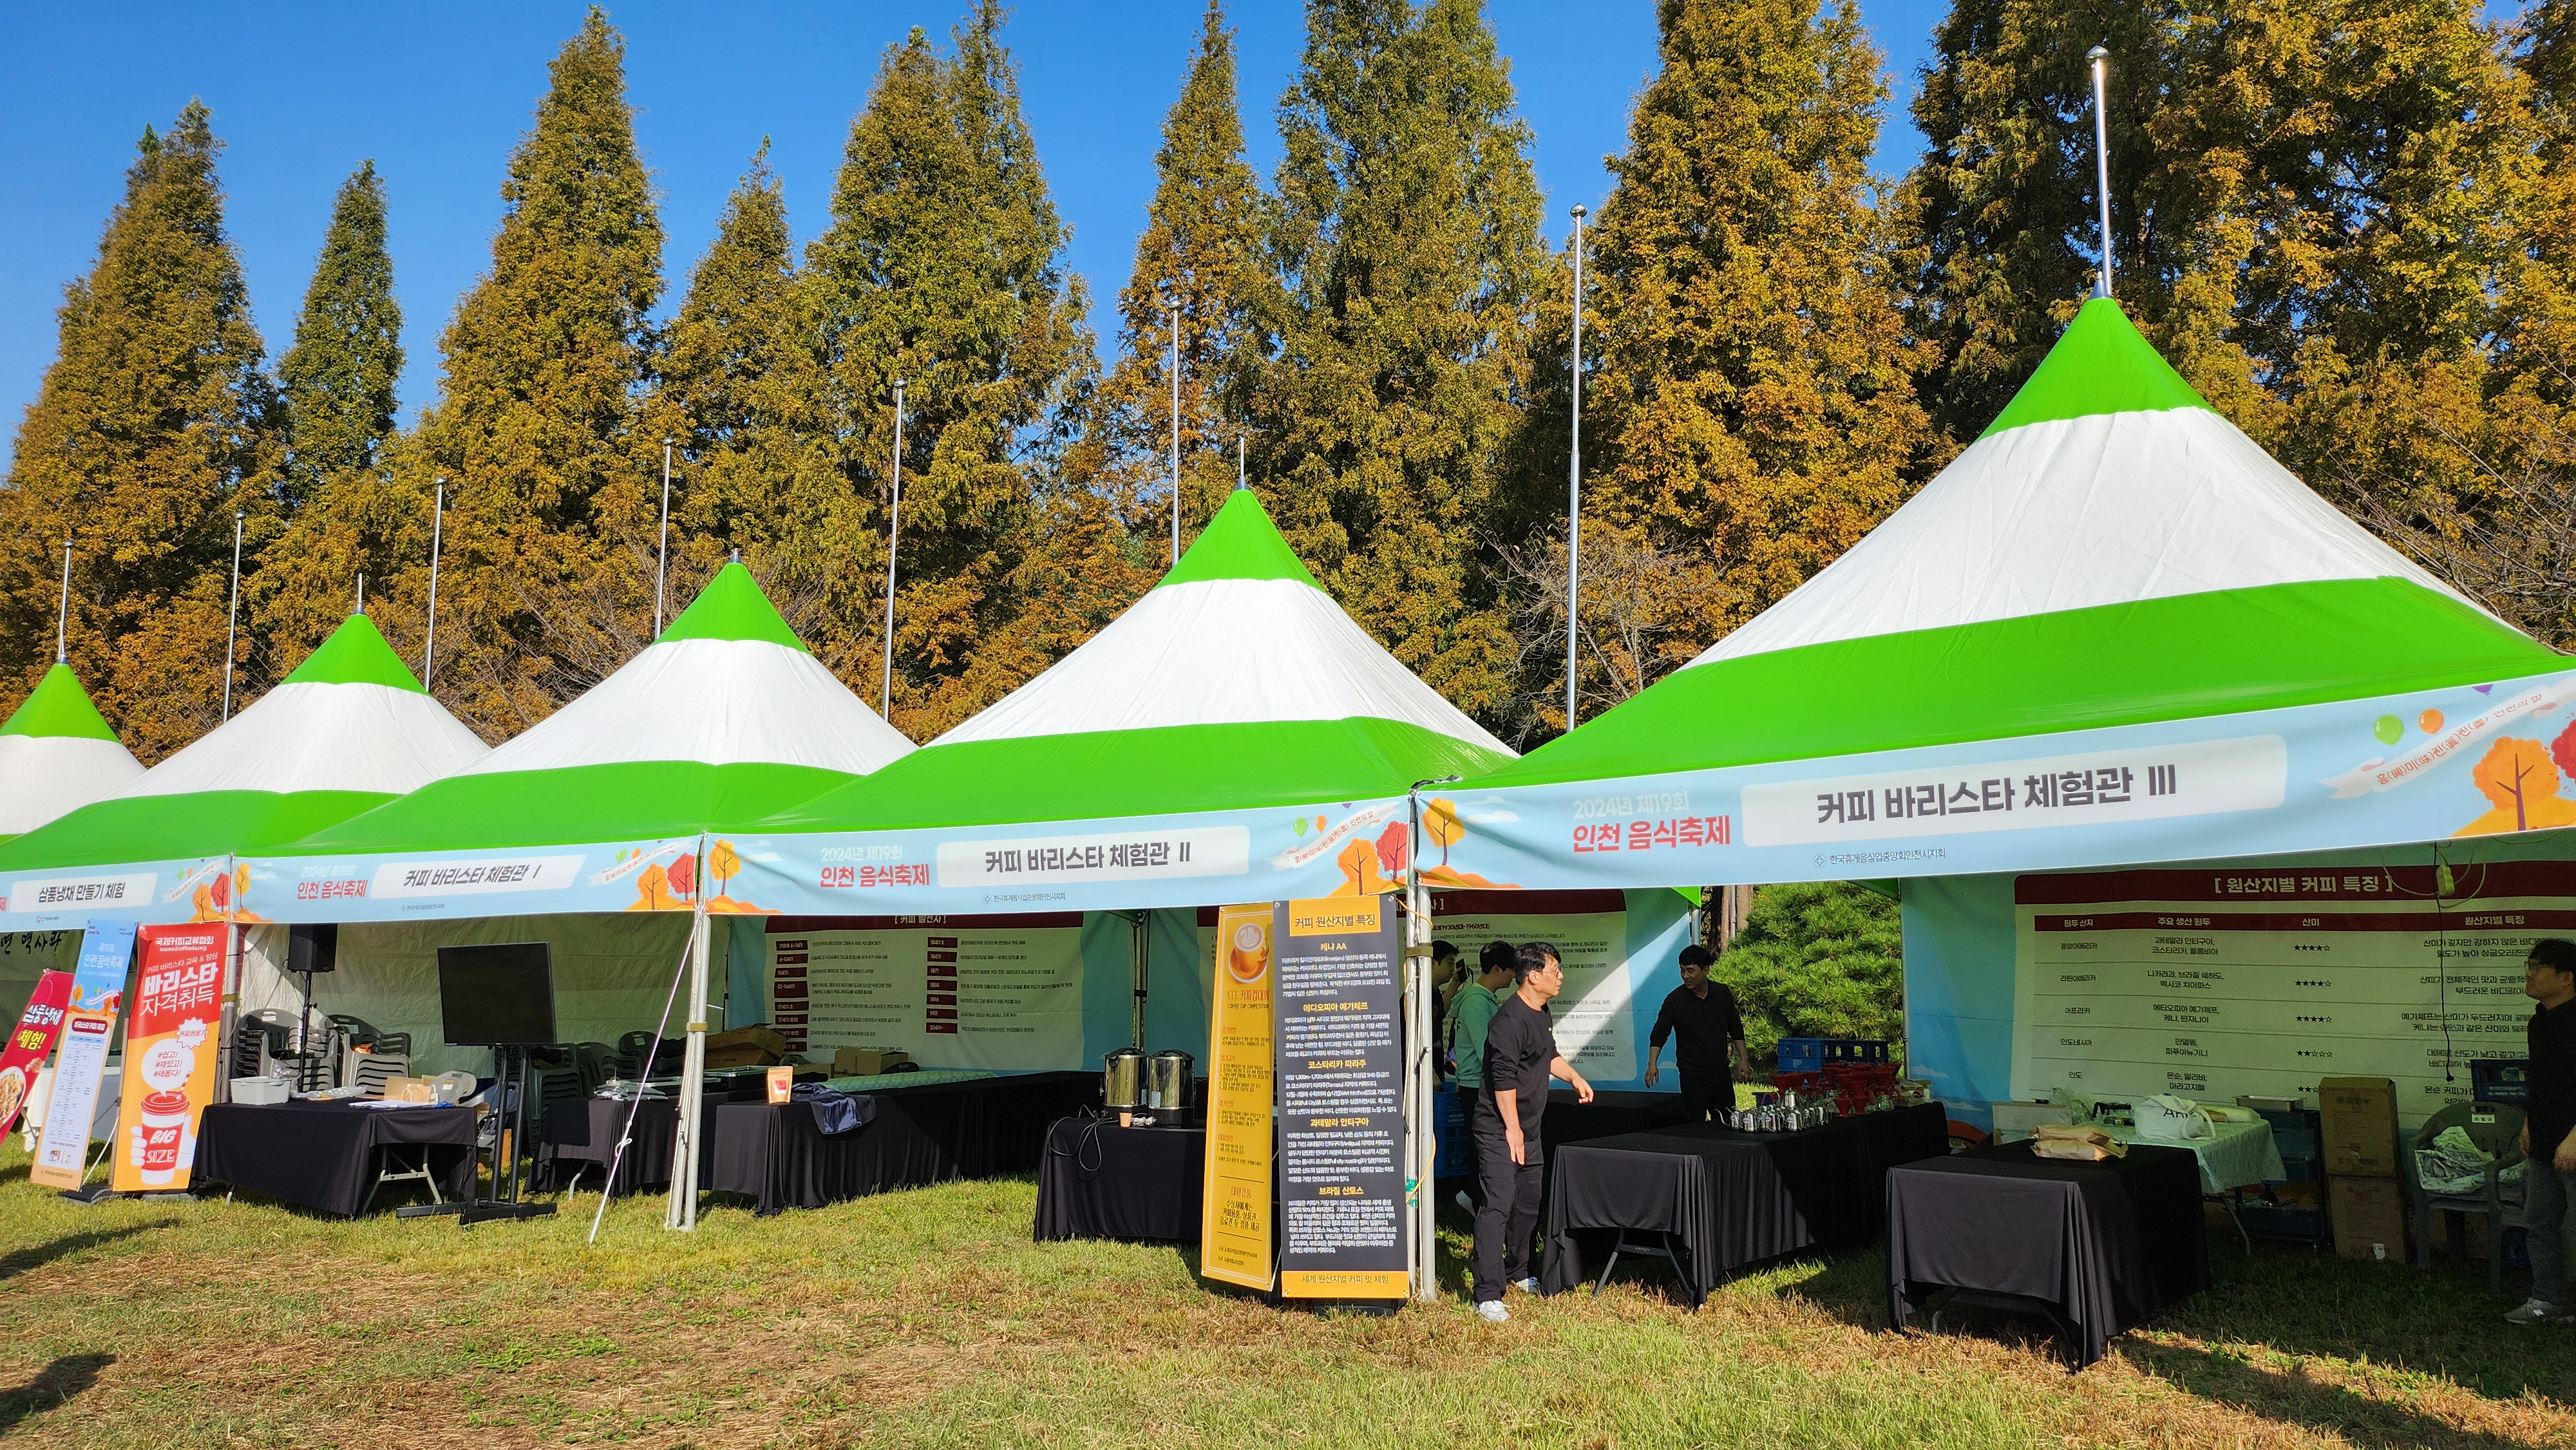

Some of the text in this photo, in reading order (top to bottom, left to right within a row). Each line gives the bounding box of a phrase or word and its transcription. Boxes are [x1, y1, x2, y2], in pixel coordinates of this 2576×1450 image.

[2494, 699, 2528, 718] 인천의
[1817, 789, 1875, 824] 커피
[1885, 777, 2015, 819] 바리스타
[2023, 764, 2134, 808] 체험관
[1573, 791, 1689, 819] 2024년 제19회
[1573, 815, 1731, 853] 인천 음식축제
[821, 844, 902, 862] 2024년 제19회
[985, 851, 1022, 873] 커피
[1027, 846, 1104, 871] 바리스타
[1109, 843, 1170, 868] 체험관
[1830, 848, 1946, 865] 한국휴게음식업중앙회인천시지회
[301, 864, 357, 878] 2024년 제19회
[403, 869, 433, 887] 커피
[431, 867, 484, 885] 바리스타
[484, 865, 529, 883] 체험관
[820, 863, 929, 888] 인천 음식축제
[76, 883, 105, 901] 만들기
[104, 882, 126, 899] 체험
[297, 880, 368, 899] 인천 음식축제
[2226, 876, 2378, 893] 원산지별 커피 특징
[900, 915, 915, 923] 커피
[1295, 914, 1376, 928] 커피 원산지별 특징
[2079, 919, 2093, 927] 산지
[2158, 918, 2174, 926] 주요
[2176, 918, 2192, 926] 생산
[2194, 918, 2210, 926] 원두
[2302, 918, 2320, 927] 산미
[2465, 916, 2503, 925] 원산지별
[2505, 915, 2524, 925] 특징
[156, 936, 214, 946] 국제커피교류협회
[1320, 943, 1335, 951] 케냐
[2155, 937, 2183, 945] 과테말라
[2474, 938, 2499, 946] 강하지
[84, 954, 125, 969] 인천 음식축제
[160, 959, 185, 970] 바리스타
[206, 952, 218, 961] 양성
[144, 962, 219, 996] 바리스타
[2060, 974, 2096, 983] 라틴아메리카
[2183, 981, 2211, 990] 치아파스
[140, 984, 215, 1016] 자격취득
[1227, 990, 1269, 1001] CCC 커피컵대회
[1303, 1002, 1368, 1012] 에디오피아 예가체프
[2153, 1004, 2188, 1012] 에티오피아
[2181, 1015, 2209, 1024] 탄자니아
[2401, 1013, 2443, 1021] 예가체프는
[17, 1029, 47, 1050] 체험!
[2165, 1048, 2208, 1057] 파푸아뉴기니
[1307, 1059, 1367, 1069] 코스타리카 따라주
[2443, 1086, 2467, 1095] 커피가
[1310, 1117, 1369, 1127] 과테말라 안티구아
[149, 1130, 177, 1144] BIG
[146, 1149, 175, 1163] SIZE
[1231, 1186, 1251, 1198] 대회경품
[1319, 1187, 1340, 1195] 브라질
[1220, 1216, 1260, 1232] 음료권 등 경품 제공
[1302, 1275, 1388, 1283] 세계 원산지별 커피 맛 체험
